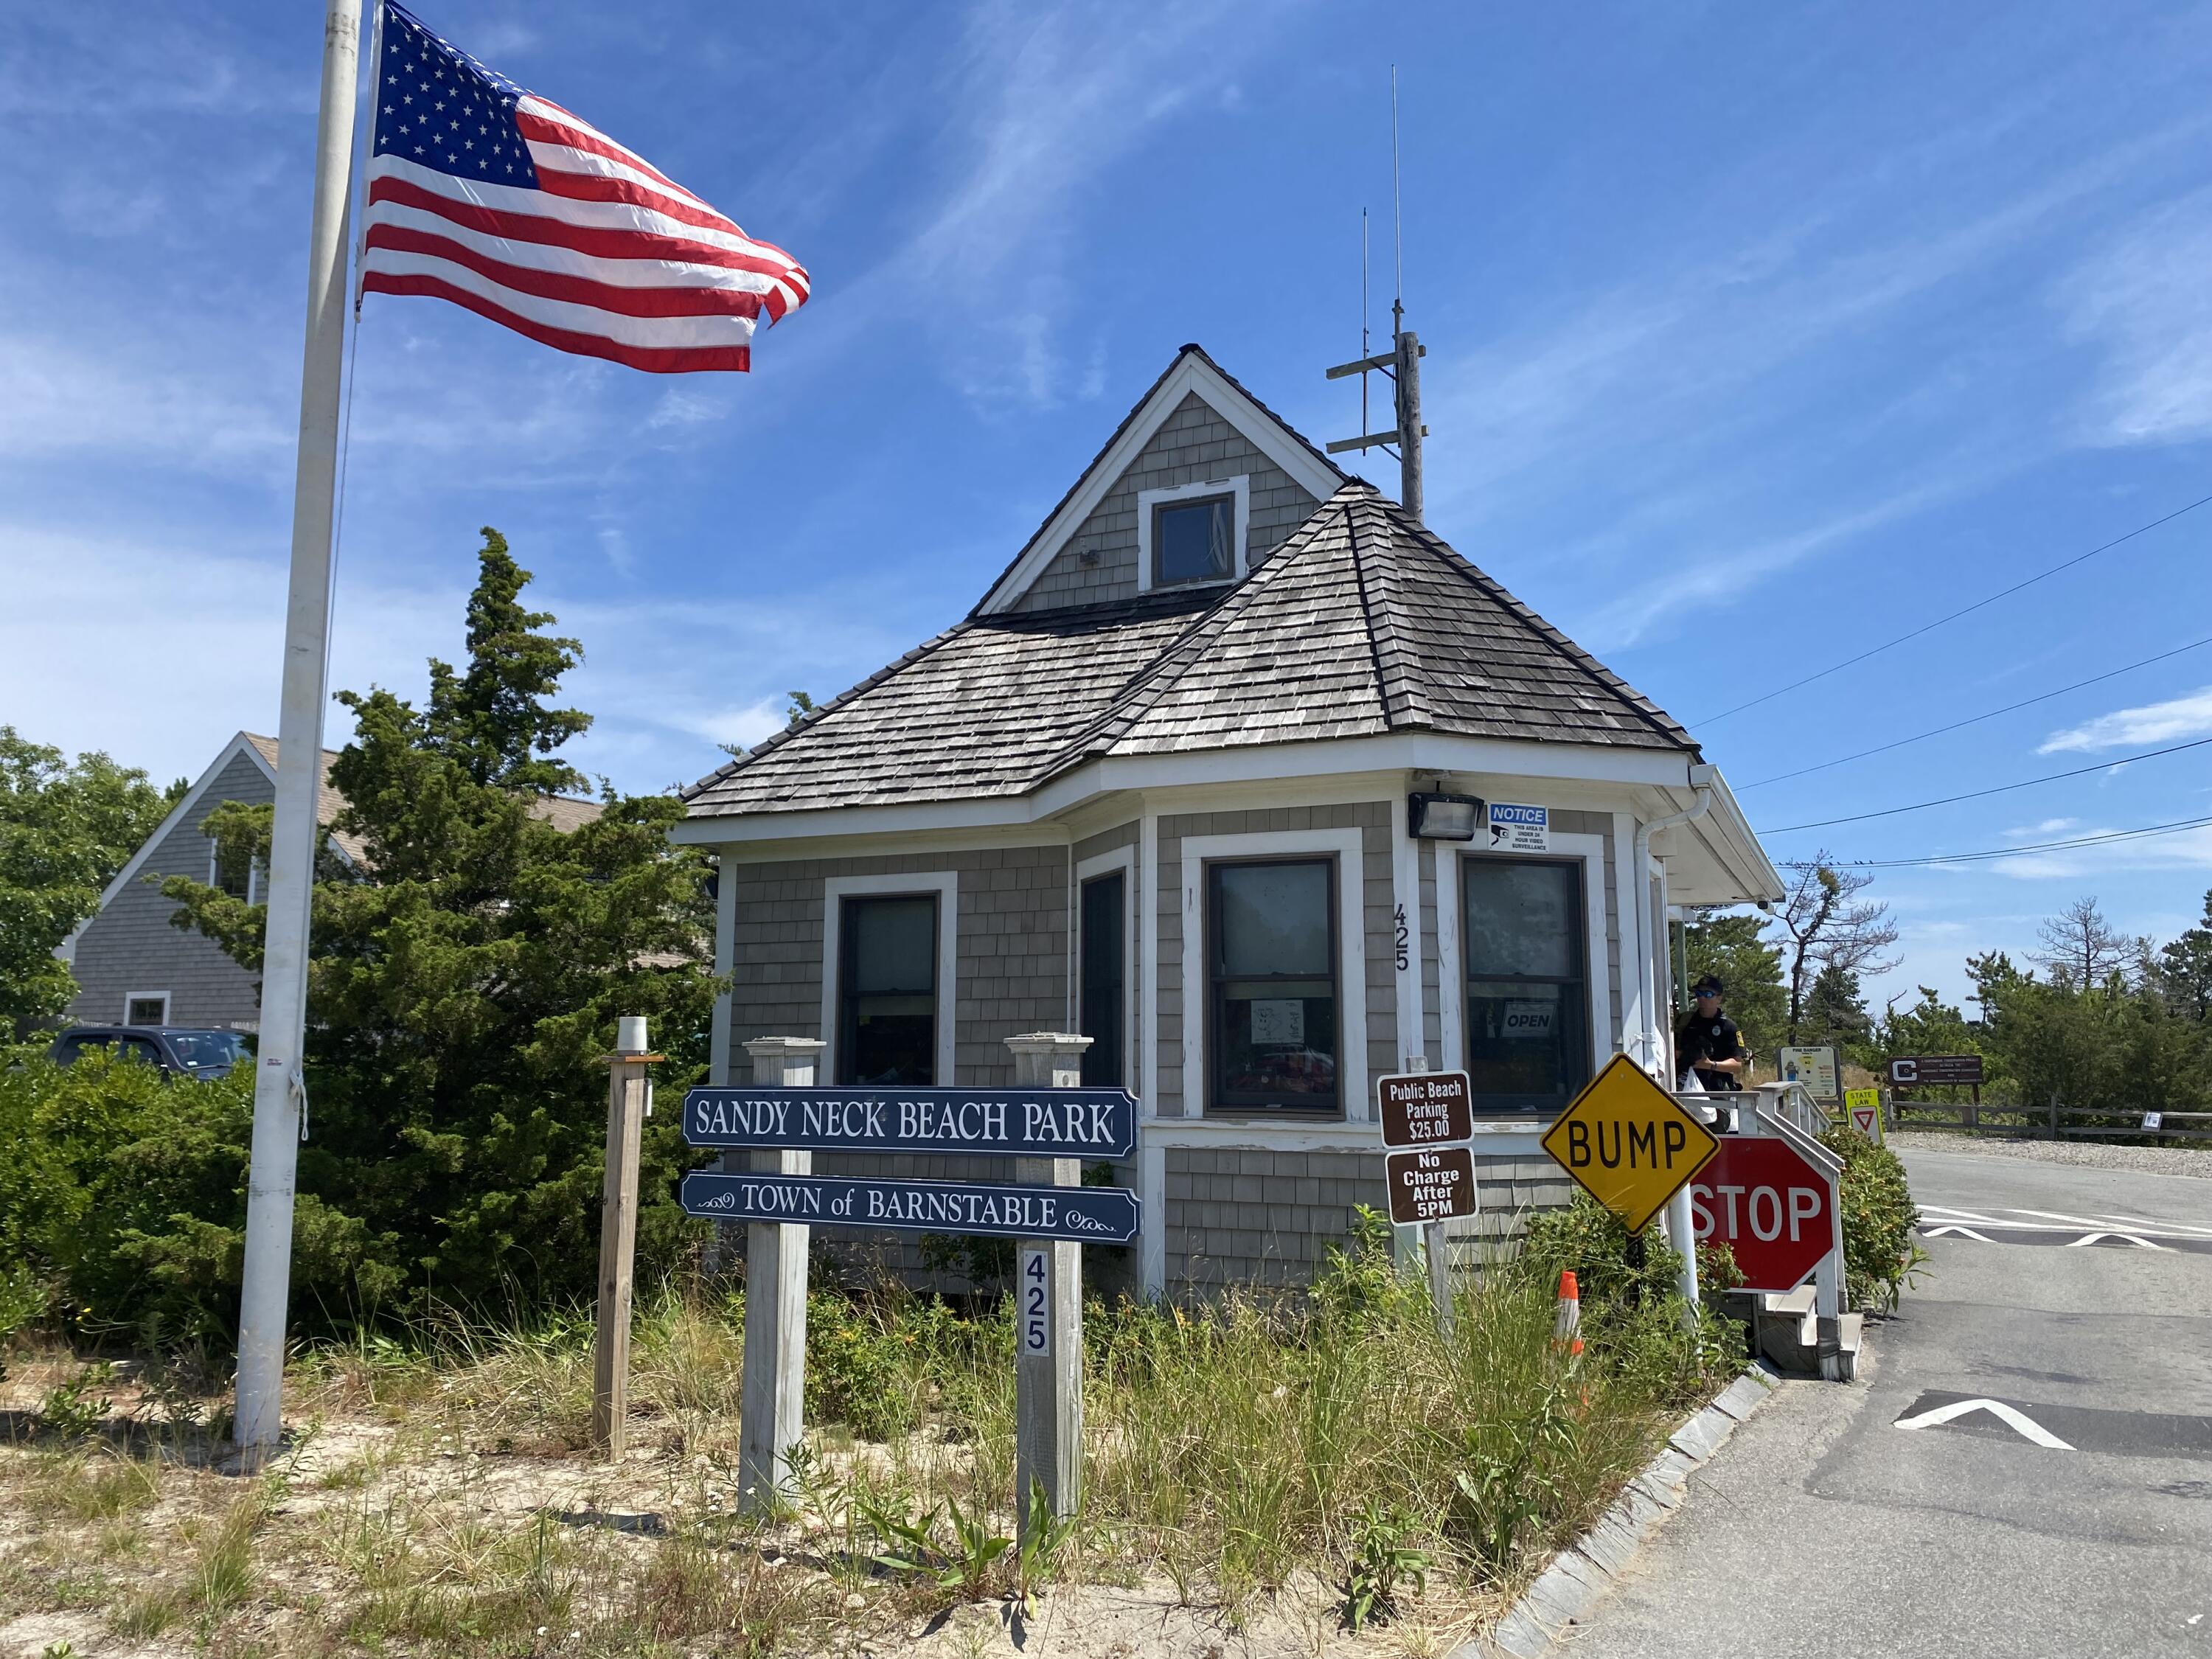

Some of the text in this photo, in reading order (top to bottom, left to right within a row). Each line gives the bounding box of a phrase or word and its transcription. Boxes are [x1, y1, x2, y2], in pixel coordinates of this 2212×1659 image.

[1493, 807, 1543, 822] NOTICE
[1394, 904, 1408, 970] 425
[1508, 1015, 1549, 1027] OPEN
[1390, 1080, 1461, 1101] Public Beach
[1406, 1102, 1450, 1120] Parking
[695, 1099, 1115, 1145] SANDY NECK BEACH PARK
[1409, 1119, 1450, 1141] $25.00
[1568, 1120, 1686, 1169] BUMP
[1419, 1154, 1440, 1168] No
[1403, 1169, 1460, 1186] Charge
[1413, 1186, 1453, 1202] After
[741, 1184, 1057, 1228] TOWN of BARNSTABLE
[1417, 1200, 1453, 1217] 5PM
[1691, 1183, 1821, 1242] STOP
[1027, 1255, 1045, 1349] 425
